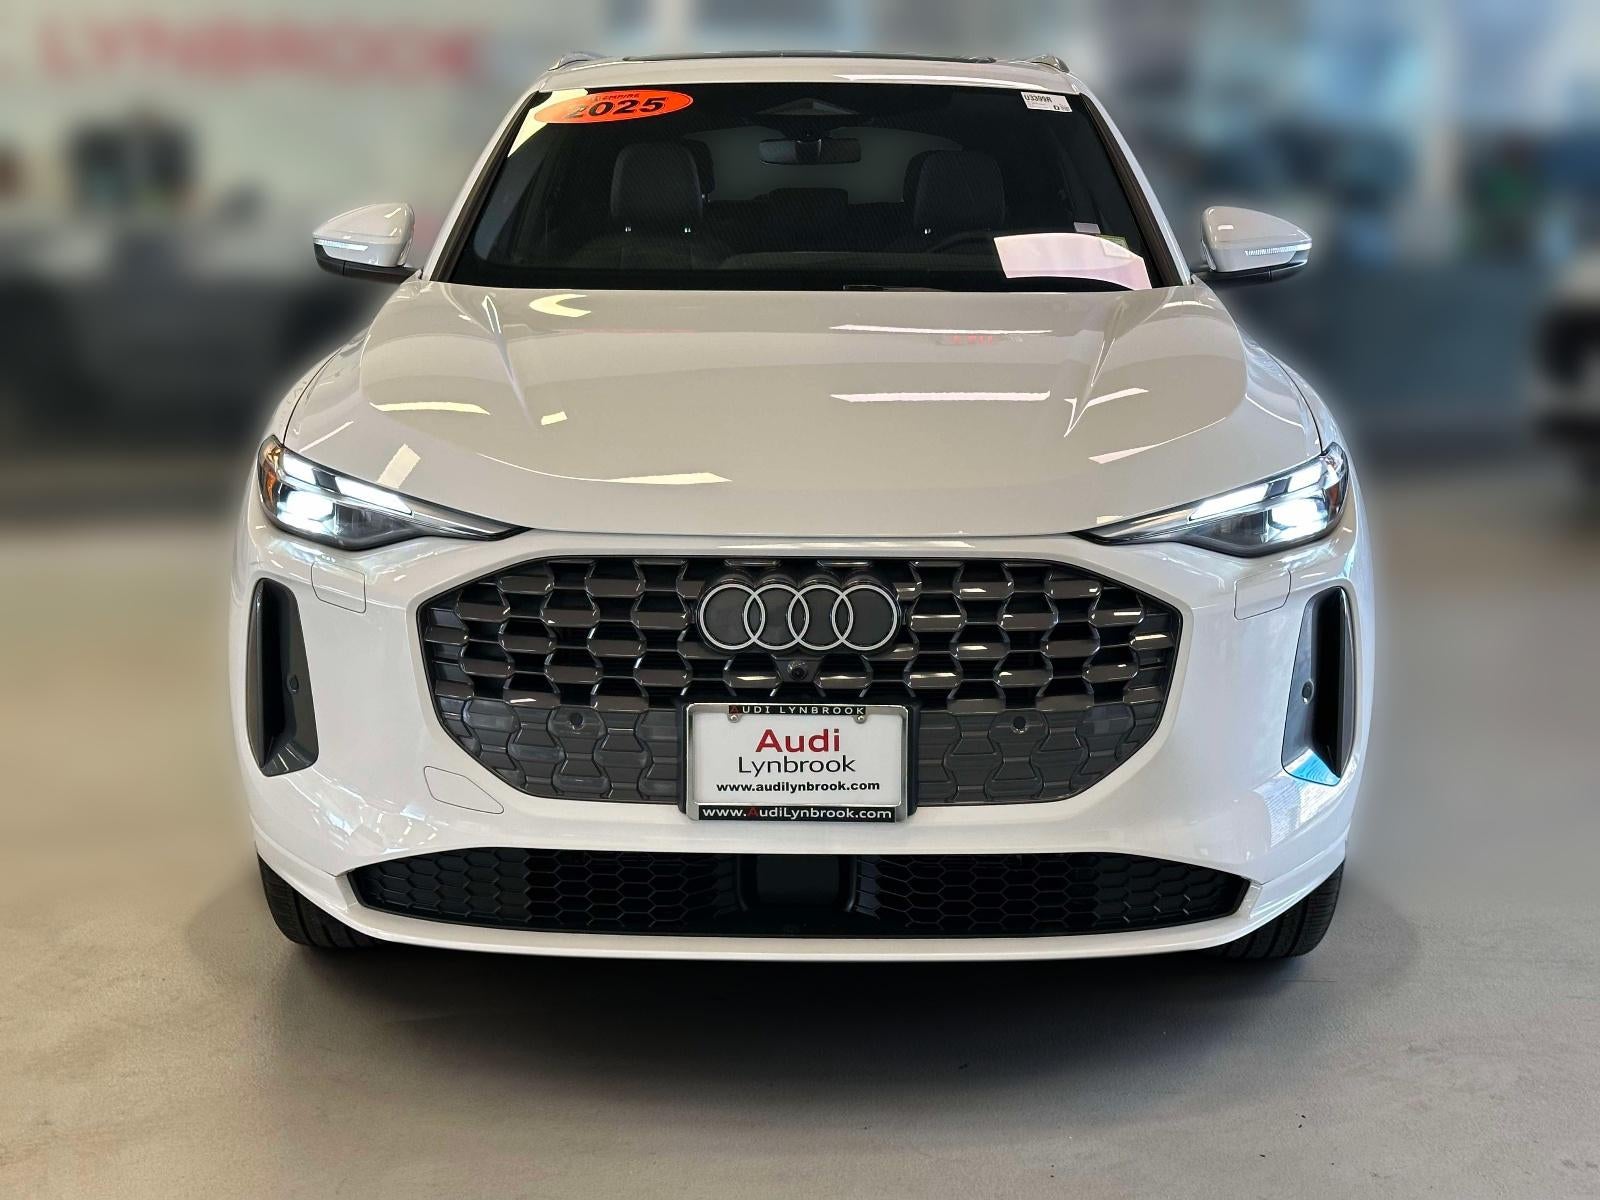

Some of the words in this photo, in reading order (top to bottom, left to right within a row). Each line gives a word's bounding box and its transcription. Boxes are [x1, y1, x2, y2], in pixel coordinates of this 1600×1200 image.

[564, 97, 667, 119] 2025
[730, 705, 771, 714] AUDI
[779, 705, 866, 715] LYNBROOK
[755, 728, 840, 753] Audi
[738, 754, 857, 777] Lynbrook
[716, 781, 880, 794] www.audilynbrook.com
[702, 806, 892, 820] www.AudiLynbrook.com
